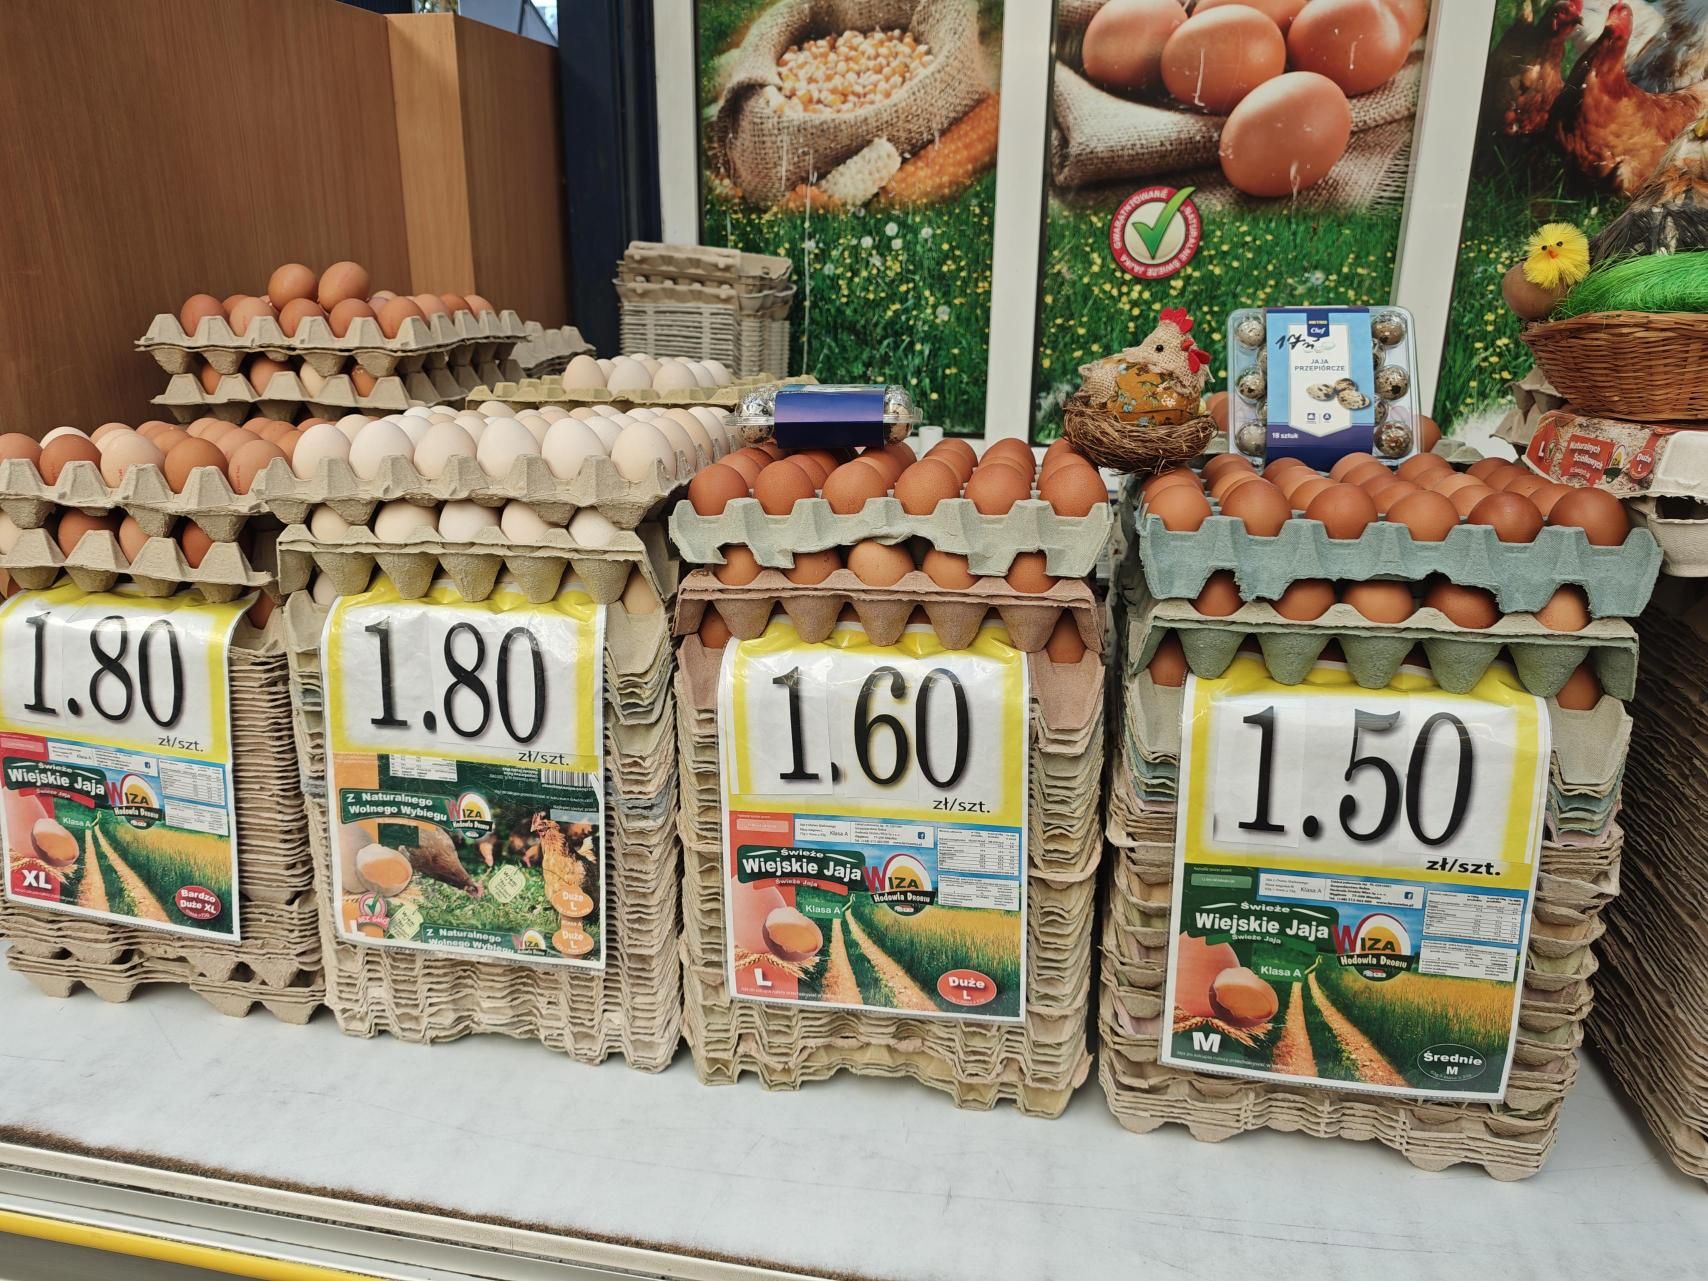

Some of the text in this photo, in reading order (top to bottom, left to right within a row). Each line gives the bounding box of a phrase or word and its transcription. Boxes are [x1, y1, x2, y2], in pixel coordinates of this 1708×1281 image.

[1310, 327, 1326, 335] Chef
[1294, 364, 1345, 372] PRZEPIÓRCZE
[23, 611, 185, 729] 1.80
[365, 616, 546, 744] 1.80
[158, 735, 205, 752] zł/szt.
[518, 750, 569, 766] zł/szt.
[38, 762, 73, 774] Świeże
[1238, 705, 1473, 846] 1.50
[7, 767, 105, 796] Wiejskie Jaja
[346, 792, 432, 806] Z Naturalnego
[932, 797, 991, 814] zł/szt.
[62, 816, 84, 827] Klasa
[349, 805, 447, 822] Wolnego Wybiegu
[780, 848, 824, 858] Świeże
[742, 858, 861, 882] Wiejskie Jaja
[1426, 856, 1502, 876] zł/szt.
[21, 869, 52, 890] XL
[863, 866, 919, 893] WIZA
[181, 889, 216, 903] Bardzo
[180, 899, 202, 910] Duże
[203, 902, 217, 914] XL
[805, 904, 841, 914] Klasa A
[1240, 901, 1291, 914] Świeże
[426, 928, 502, 942] Z Naturalnego
[1195, 912, 1329, 942] Wiejskie Jaja
[1332, 924, 1396, 954] WIZA
[1340, 954, 1377, 966] Hodowla
[753, 967, 773, 988] L
[1260, 966, 1302, 978] Klasa A
[947, 975, 985, 990] Duże
[962, 990, 972, 1001] L
[1192, 1031, 1222, 1053] M
[1423, 1050, 1483, 1066] Średnie
[1446, 1066, 1459, 1075] M
